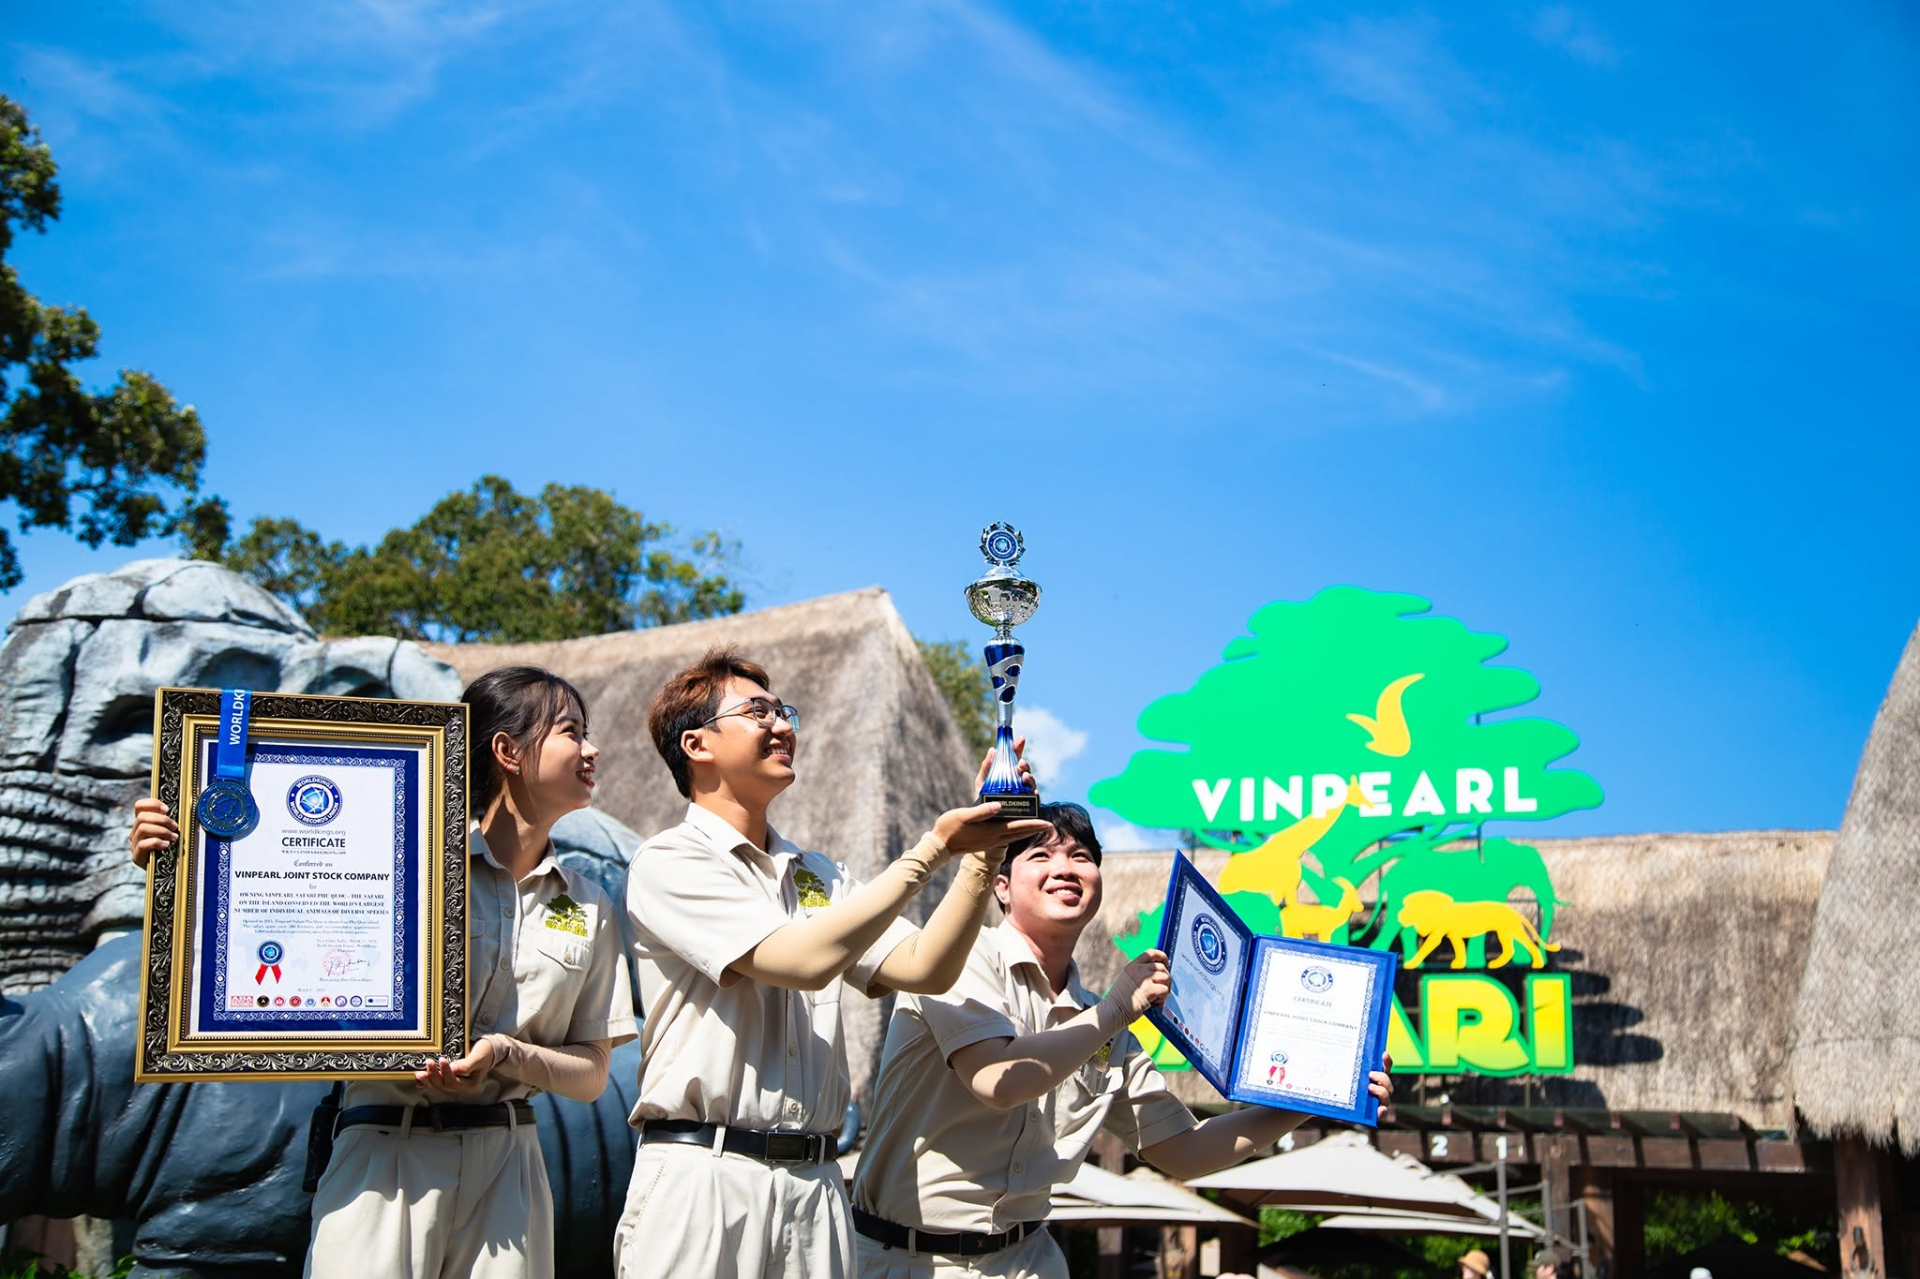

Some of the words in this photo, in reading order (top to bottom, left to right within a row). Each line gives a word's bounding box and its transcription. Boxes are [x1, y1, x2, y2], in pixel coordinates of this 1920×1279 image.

[296, 778, 333, 789] WORLDKINGS
[1191, 766, 1538, 823] VINPEARL
[281, 837, 346, 848] CERTIFICATE
[294, 859, 323, 867] Conferred
[234, 871, 282, 879] VINPEARL
[283, 871, 310, 879] JOINT
[312, 872, 342, 880] STOCK
[344, 872, 390, 881] COMPANY
[1294, 996, 1332, 1008] CERTIFICATE
[1309, 1017, 1328, 1025] STOCK
[1328, 1021, 1358, 1030] COMPANY
[1431, 1135, 1448, 1157] 2
[1495, 1136, 1507, 1159] 1
